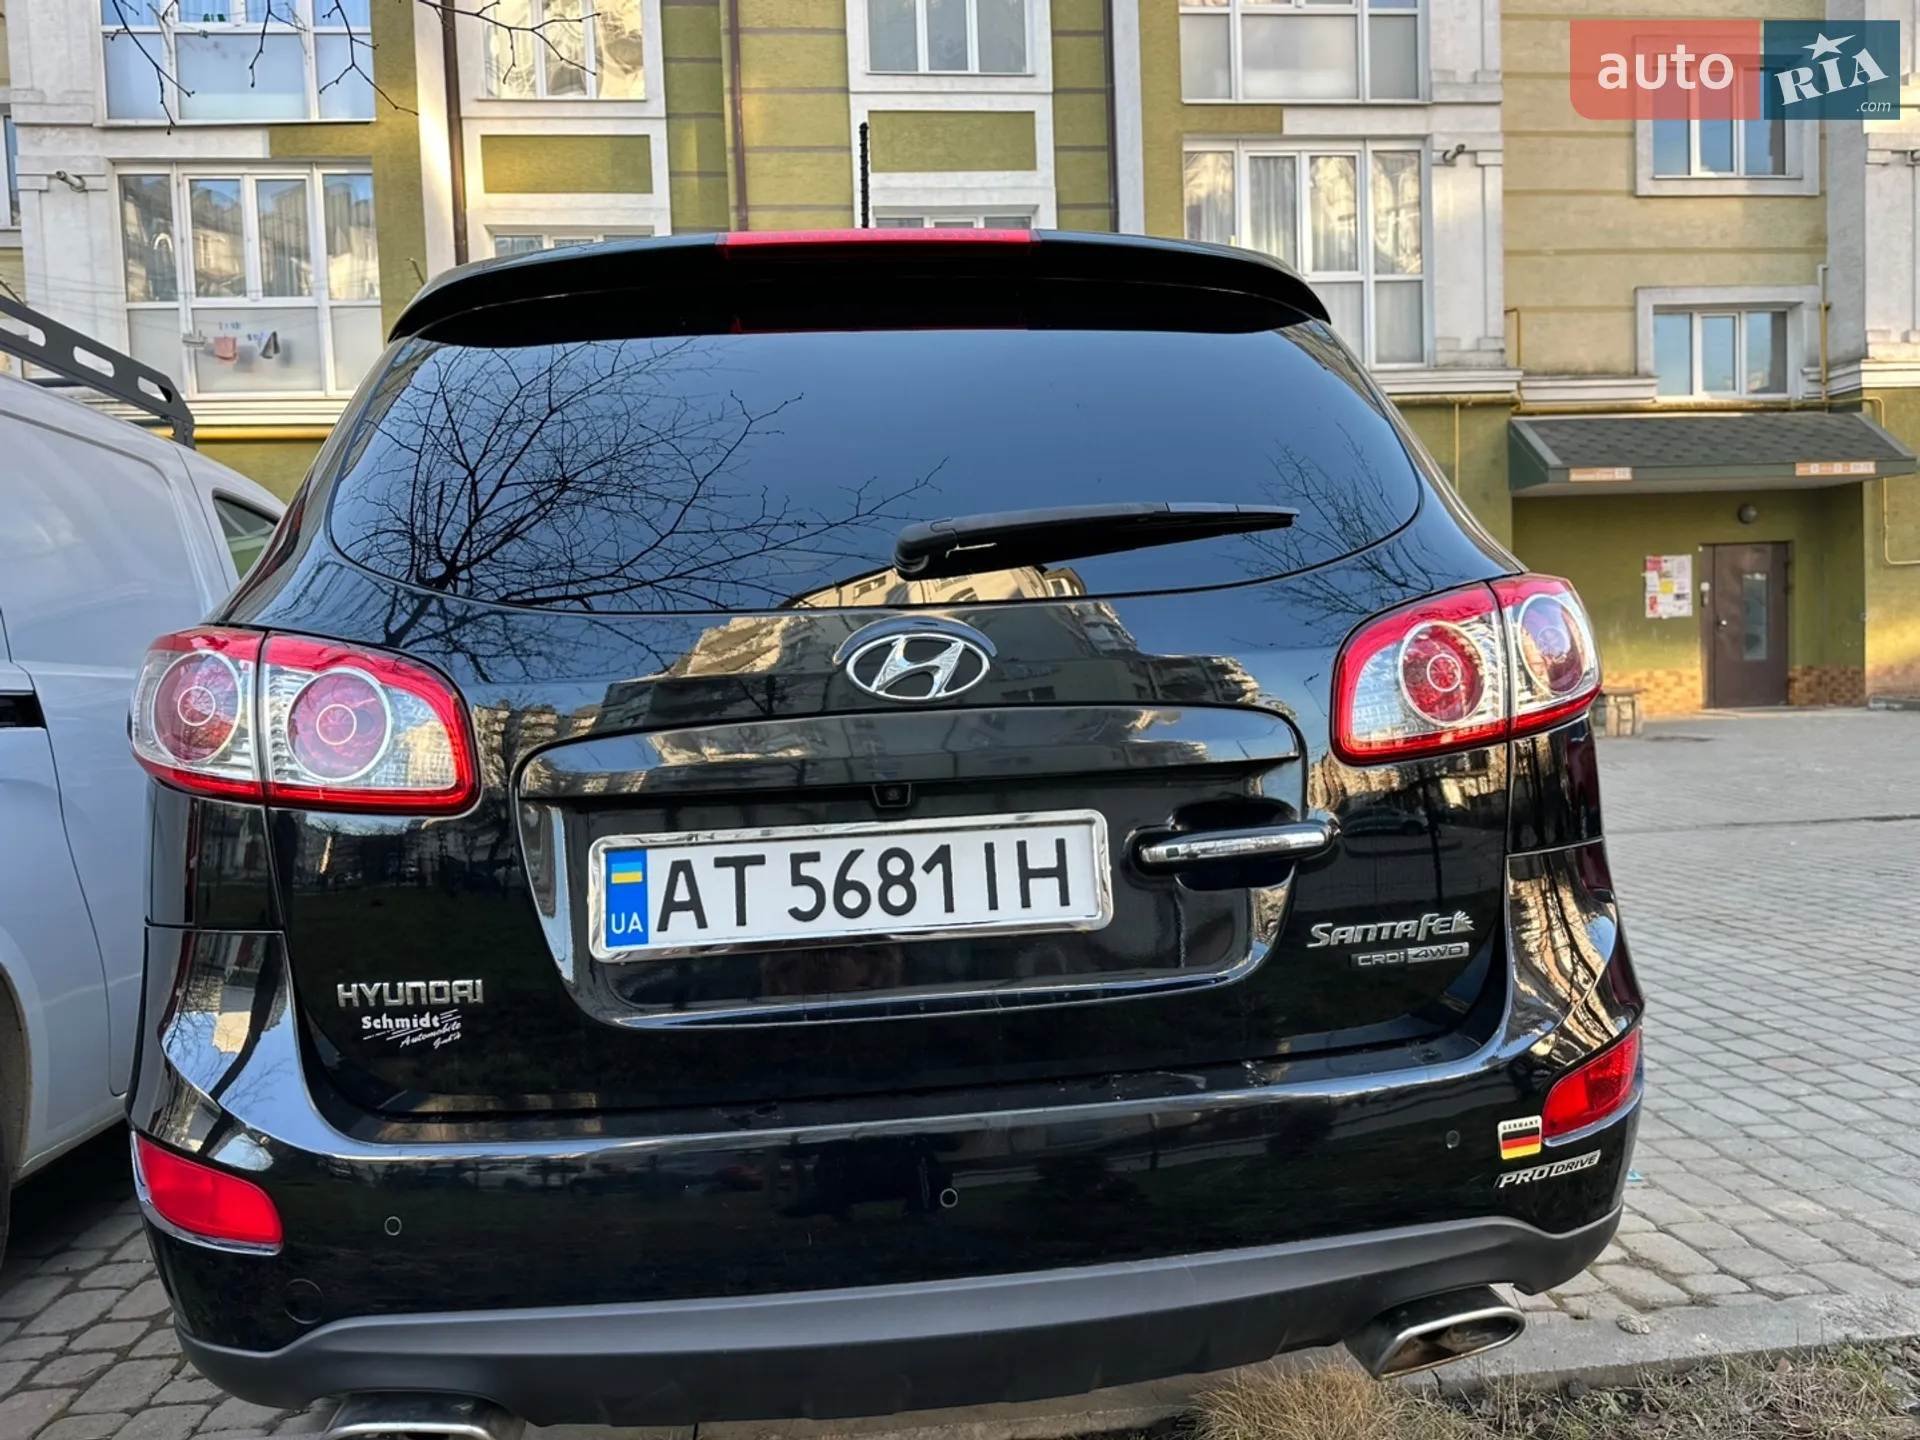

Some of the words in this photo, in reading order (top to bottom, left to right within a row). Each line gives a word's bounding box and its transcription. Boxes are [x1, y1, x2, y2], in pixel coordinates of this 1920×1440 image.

[656, 853, 766, 932] AT
[787, 844, 955, 922] 5681
[984, 837, 1071, 910] IH
[611, 912, 643, 935] UA
[1411, 945, 1464, 960] 4WD
[336, 979, 485, 1008] HYUNDAI
[361, 1011, 441, 1030] Schmidt
[1502, 1119, 1539, 1131] GERMANY
